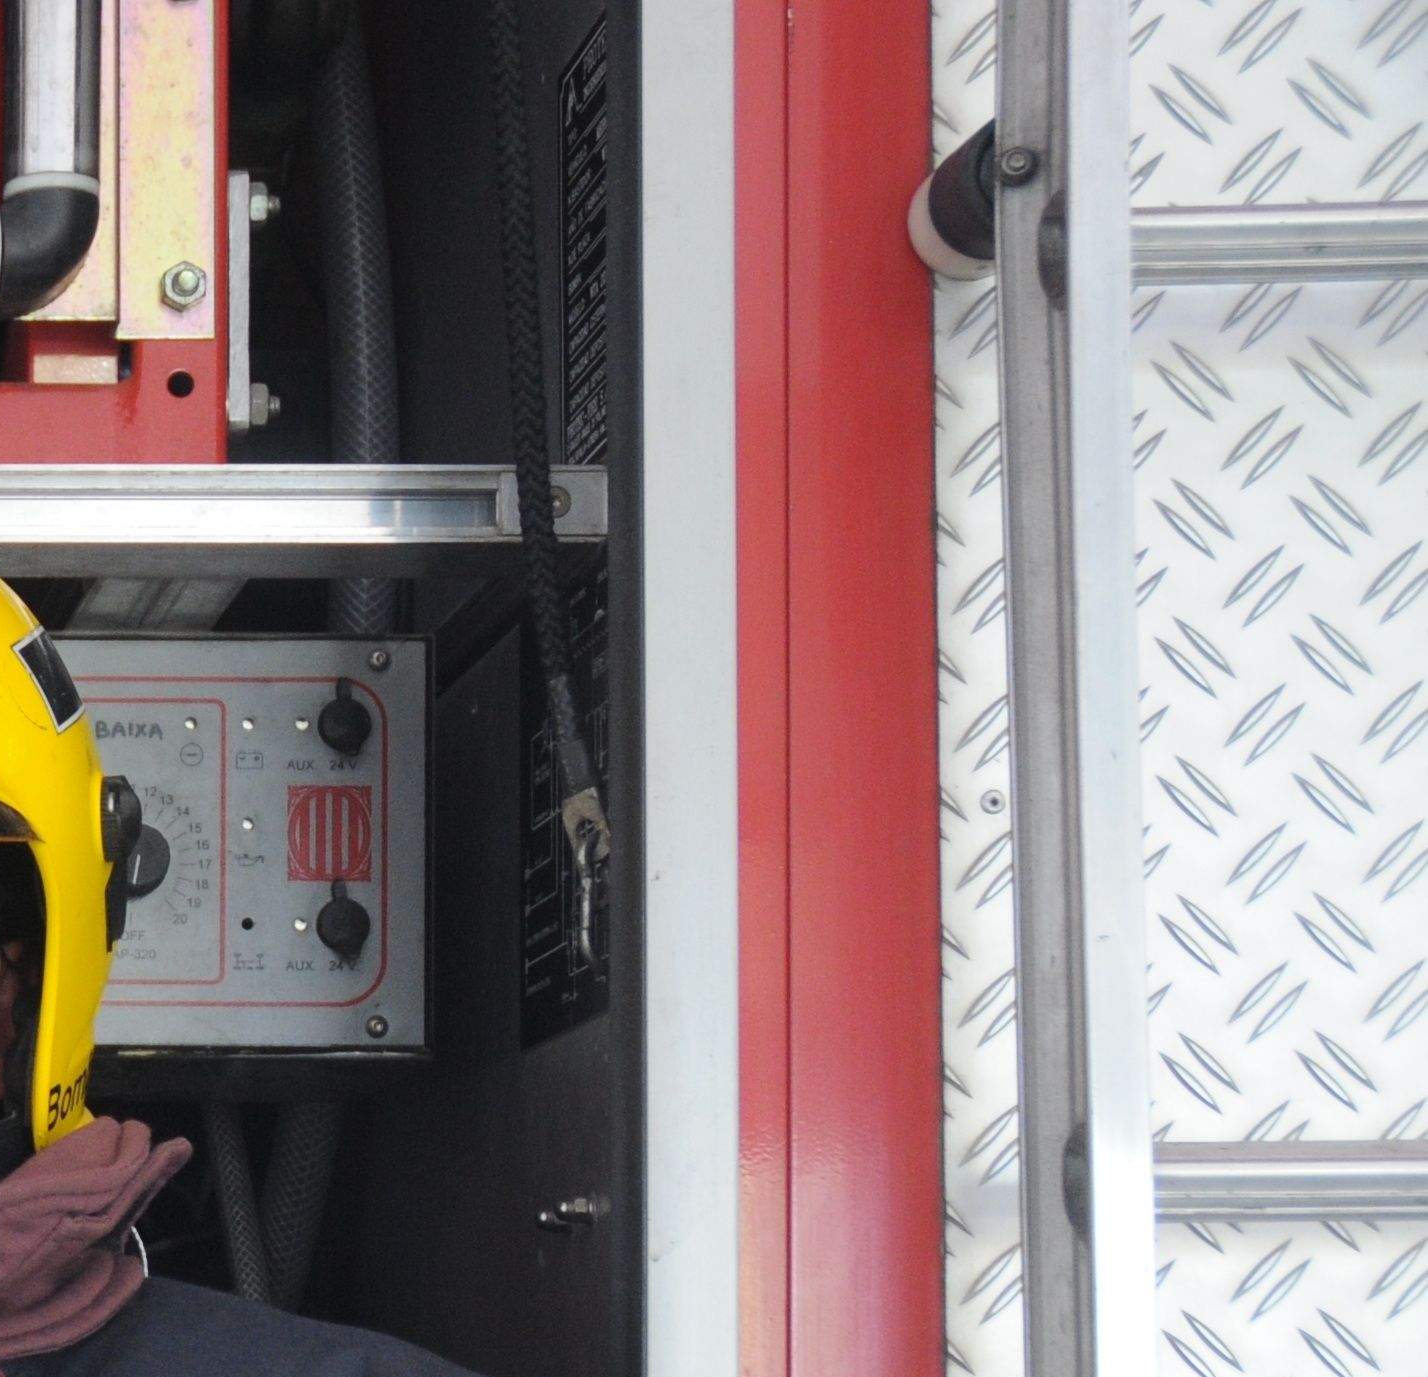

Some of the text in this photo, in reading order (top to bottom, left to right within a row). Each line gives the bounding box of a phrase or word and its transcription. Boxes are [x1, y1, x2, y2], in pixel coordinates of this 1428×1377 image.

[94, 718, 163, 741] BAIXA
[329, 760, 343, 771] 24
[144, 785, 157, 797] 12
[161, 794, 174, 806] 13
[176, 805, 191, 817] 14
[189, 822, 203, 834] 15
[196, 839, 210, 851] 16
[199, 858, 213, 870] 17
[196, 878, 209, 890] 18
[187, 896, 202, 909] 19
[171, 913, 188, 925] 20
[328, 960, 343, 972] 24
[47, 1067, 89, 1132] Bom
